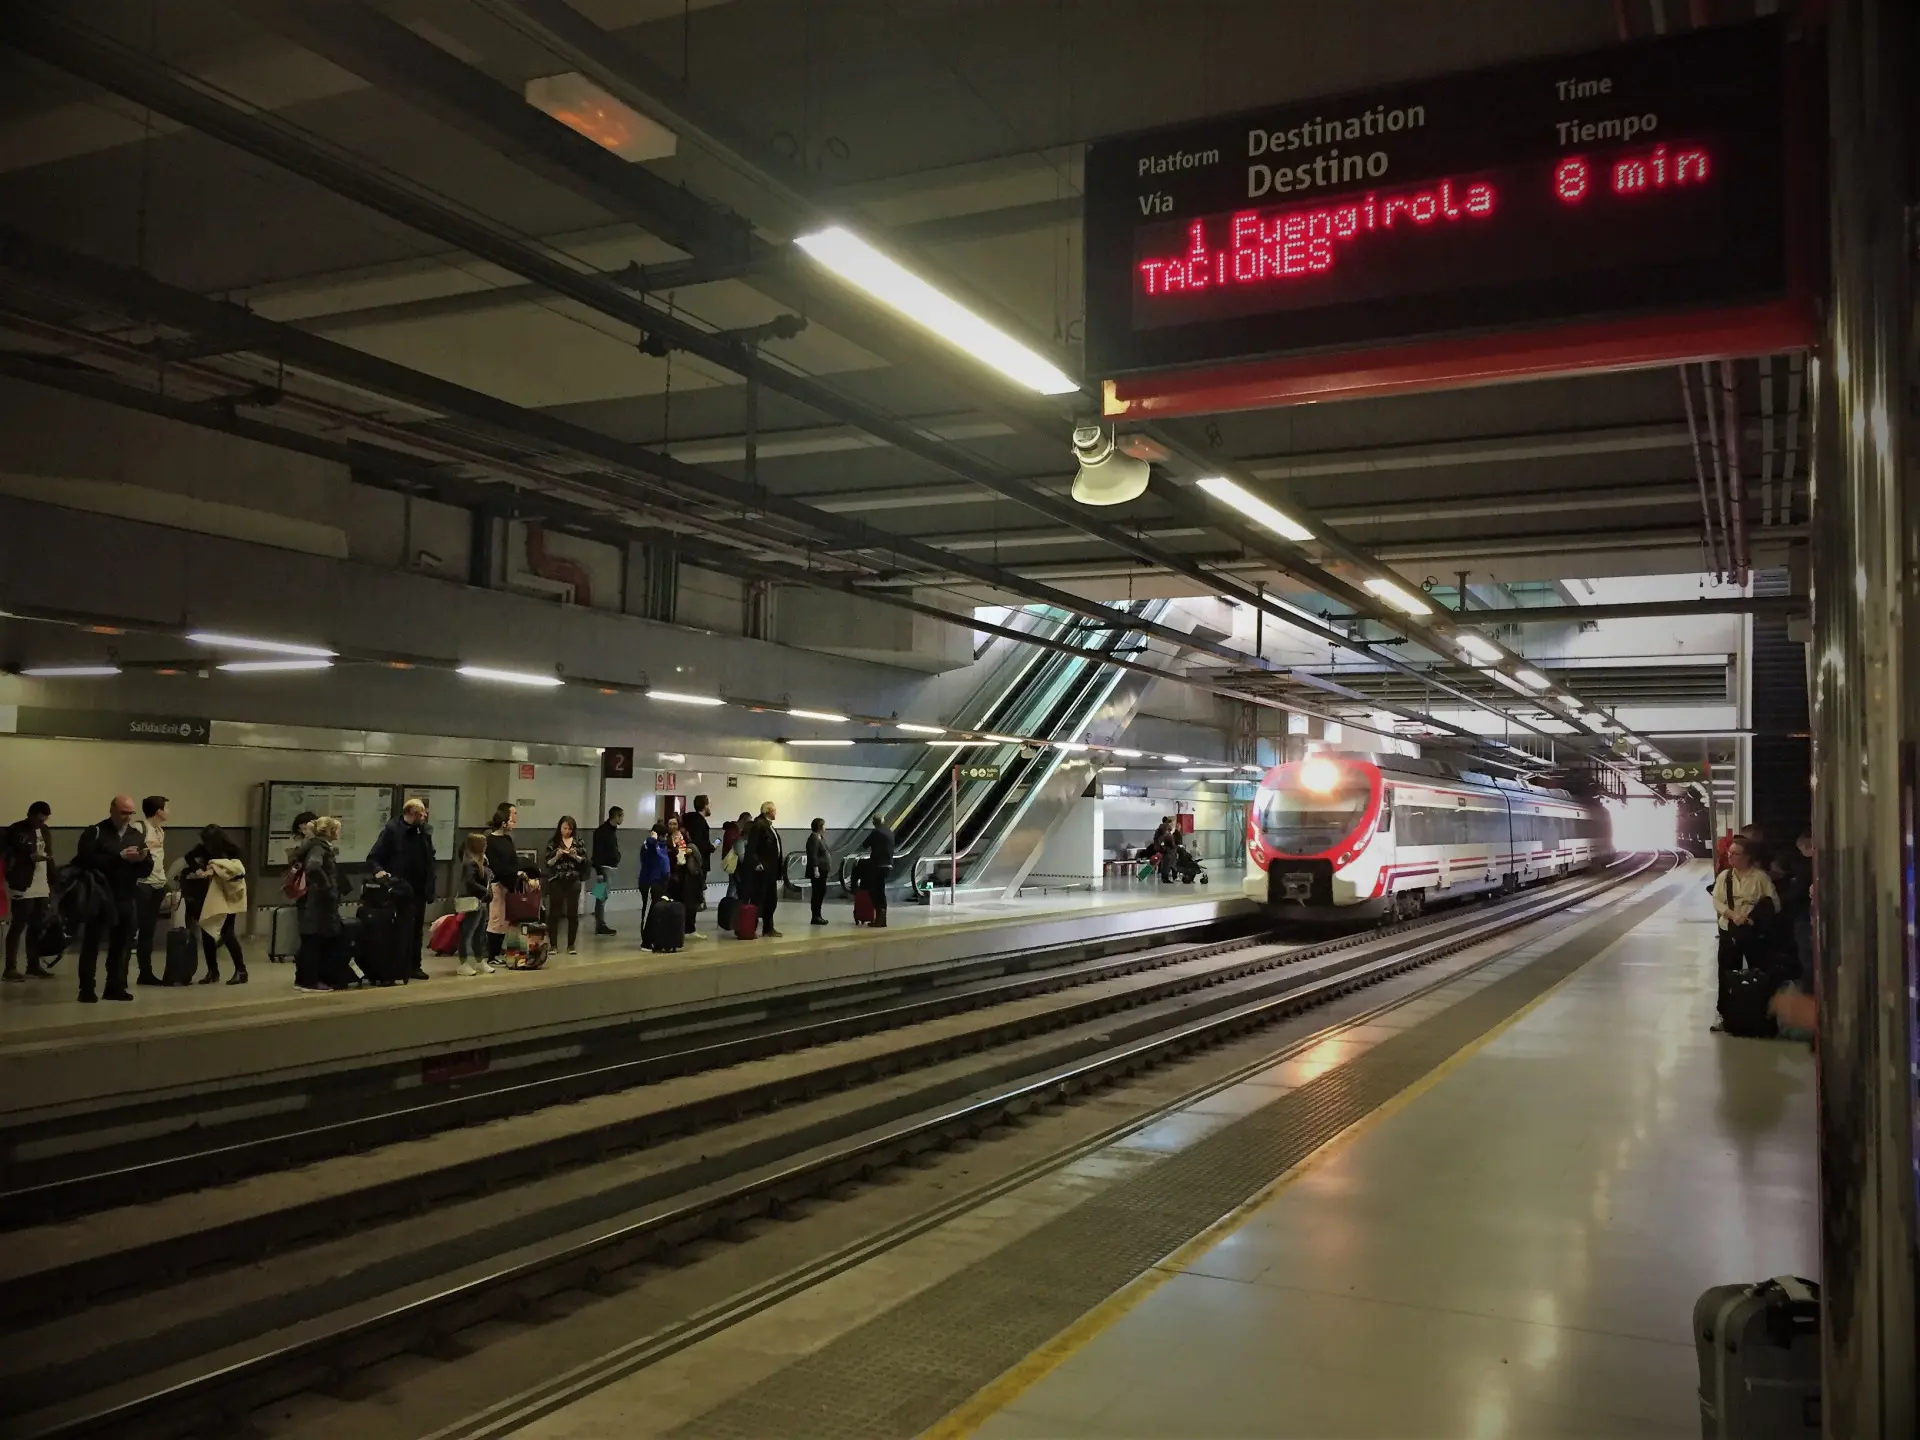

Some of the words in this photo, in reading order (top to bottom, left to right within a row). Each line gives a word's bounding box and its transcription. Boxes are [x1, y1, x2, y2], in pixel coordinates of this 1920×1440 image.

[1555, 76, 1612, 101] Time
[1247, 104, 1426, 157] Destination
[1555, 113, 1658, 146] Tiempo
[1138, 147, 1220, 176] Platform
[1247, 149, 1389, 199] Destino
[1139, 191, 1174, 216] Vía
[1191, 223, 1206, 255] 1
[1234, 182, 1493, 249] Fuengirola
[1557, 161, 1587, 198] 8
[1616, 147, 1707, 192] min
[1140, 237, 1333, 294] TACIONES
[615, 754, 625, 771] 2
